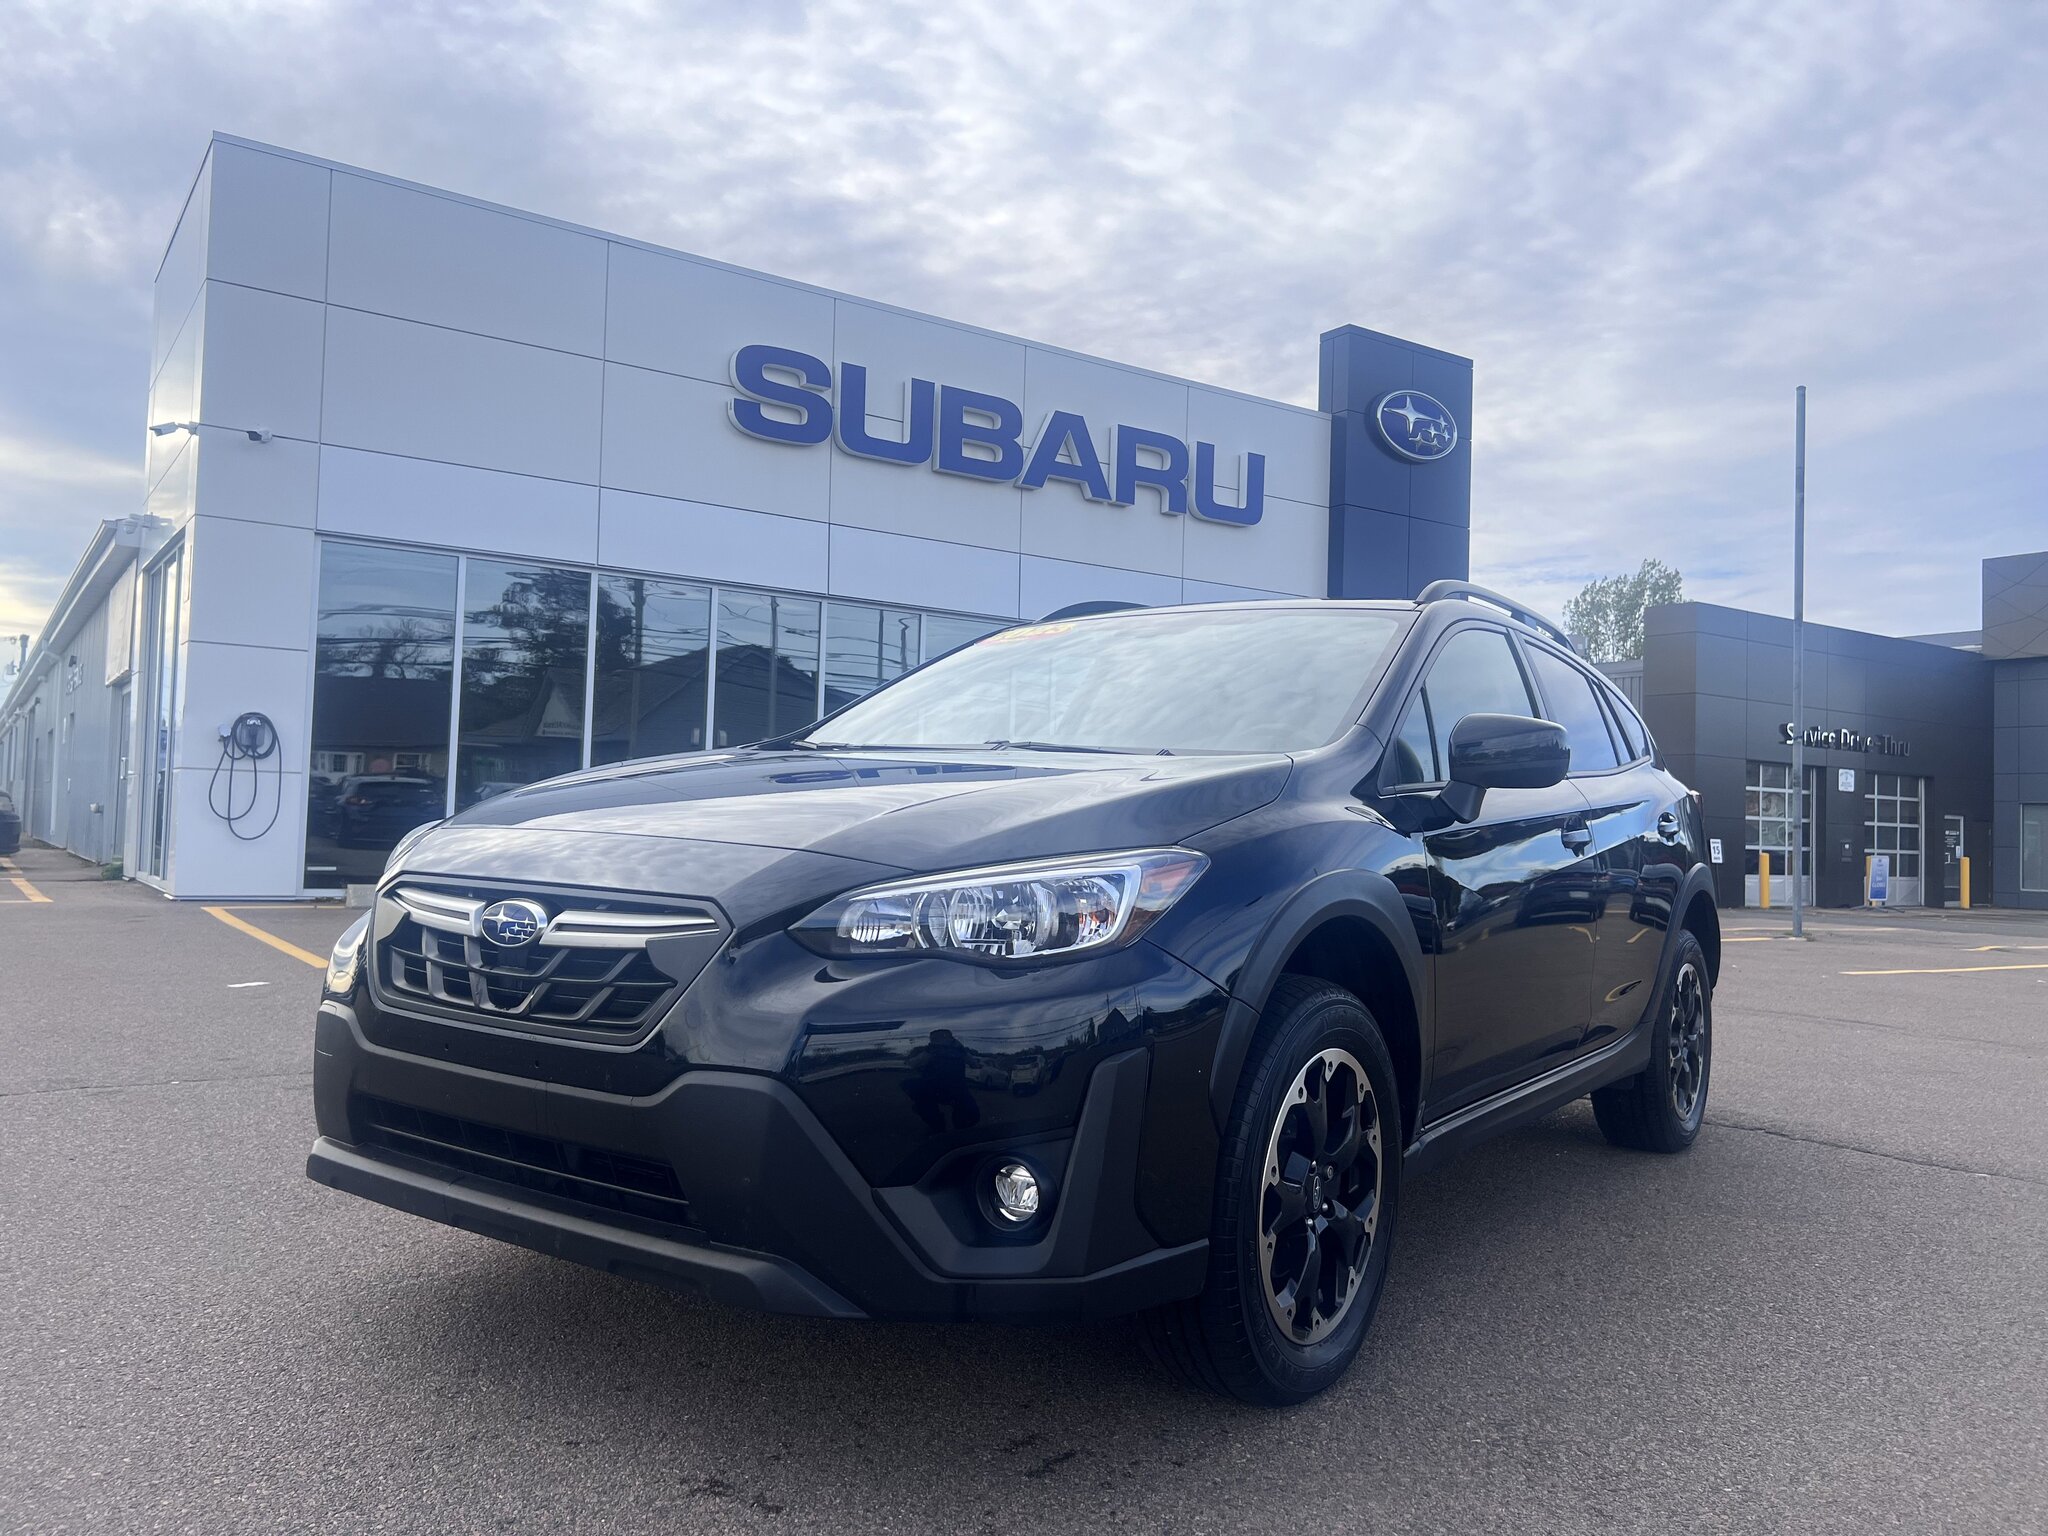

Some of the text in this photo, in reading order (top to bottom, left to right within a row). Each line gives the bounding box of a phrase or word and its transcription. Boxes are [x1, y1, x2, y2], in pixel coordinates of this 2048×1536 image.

[728, 344, 1266, 527] SUBARU
[1785, 722, 1837, 749] Srvice
[1712, 845, 1721, 856] 15
